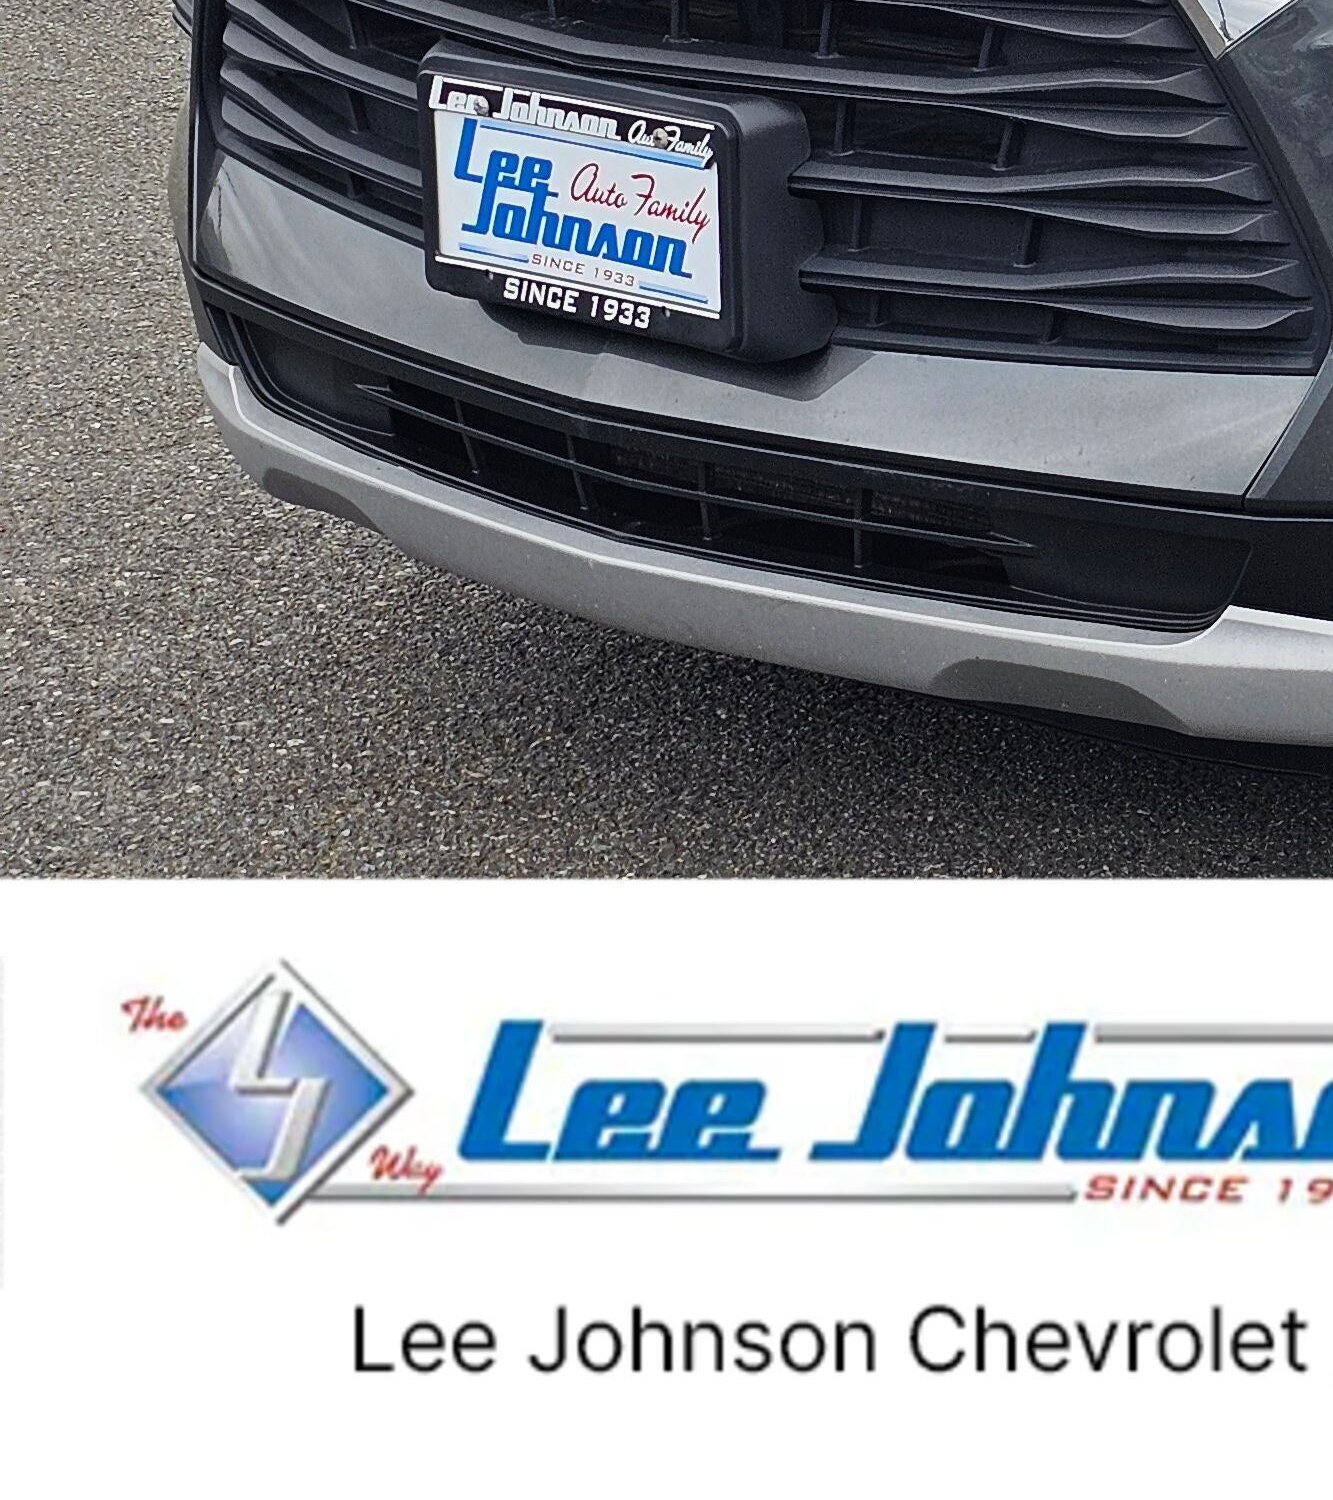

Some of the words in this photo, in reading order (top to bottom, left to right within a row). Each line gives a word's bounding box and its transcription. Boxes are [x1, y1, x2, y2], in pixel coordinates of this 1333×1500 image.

[454, 117, 560, 198] Lee
[493, 86, 622, 141] Johnson
[664, 125, 714, 168] Family
[461, 182, 693, 279] Johnson
[570, 162, 629, 209] Auto
[630, 173, 711, 244] Family
[503, 277, 580, 312] SINCE
[590, 295, 651, 329] 1933
[531, 253, 585, 275] SINCE
[594, 266, 636, 287] 1933
